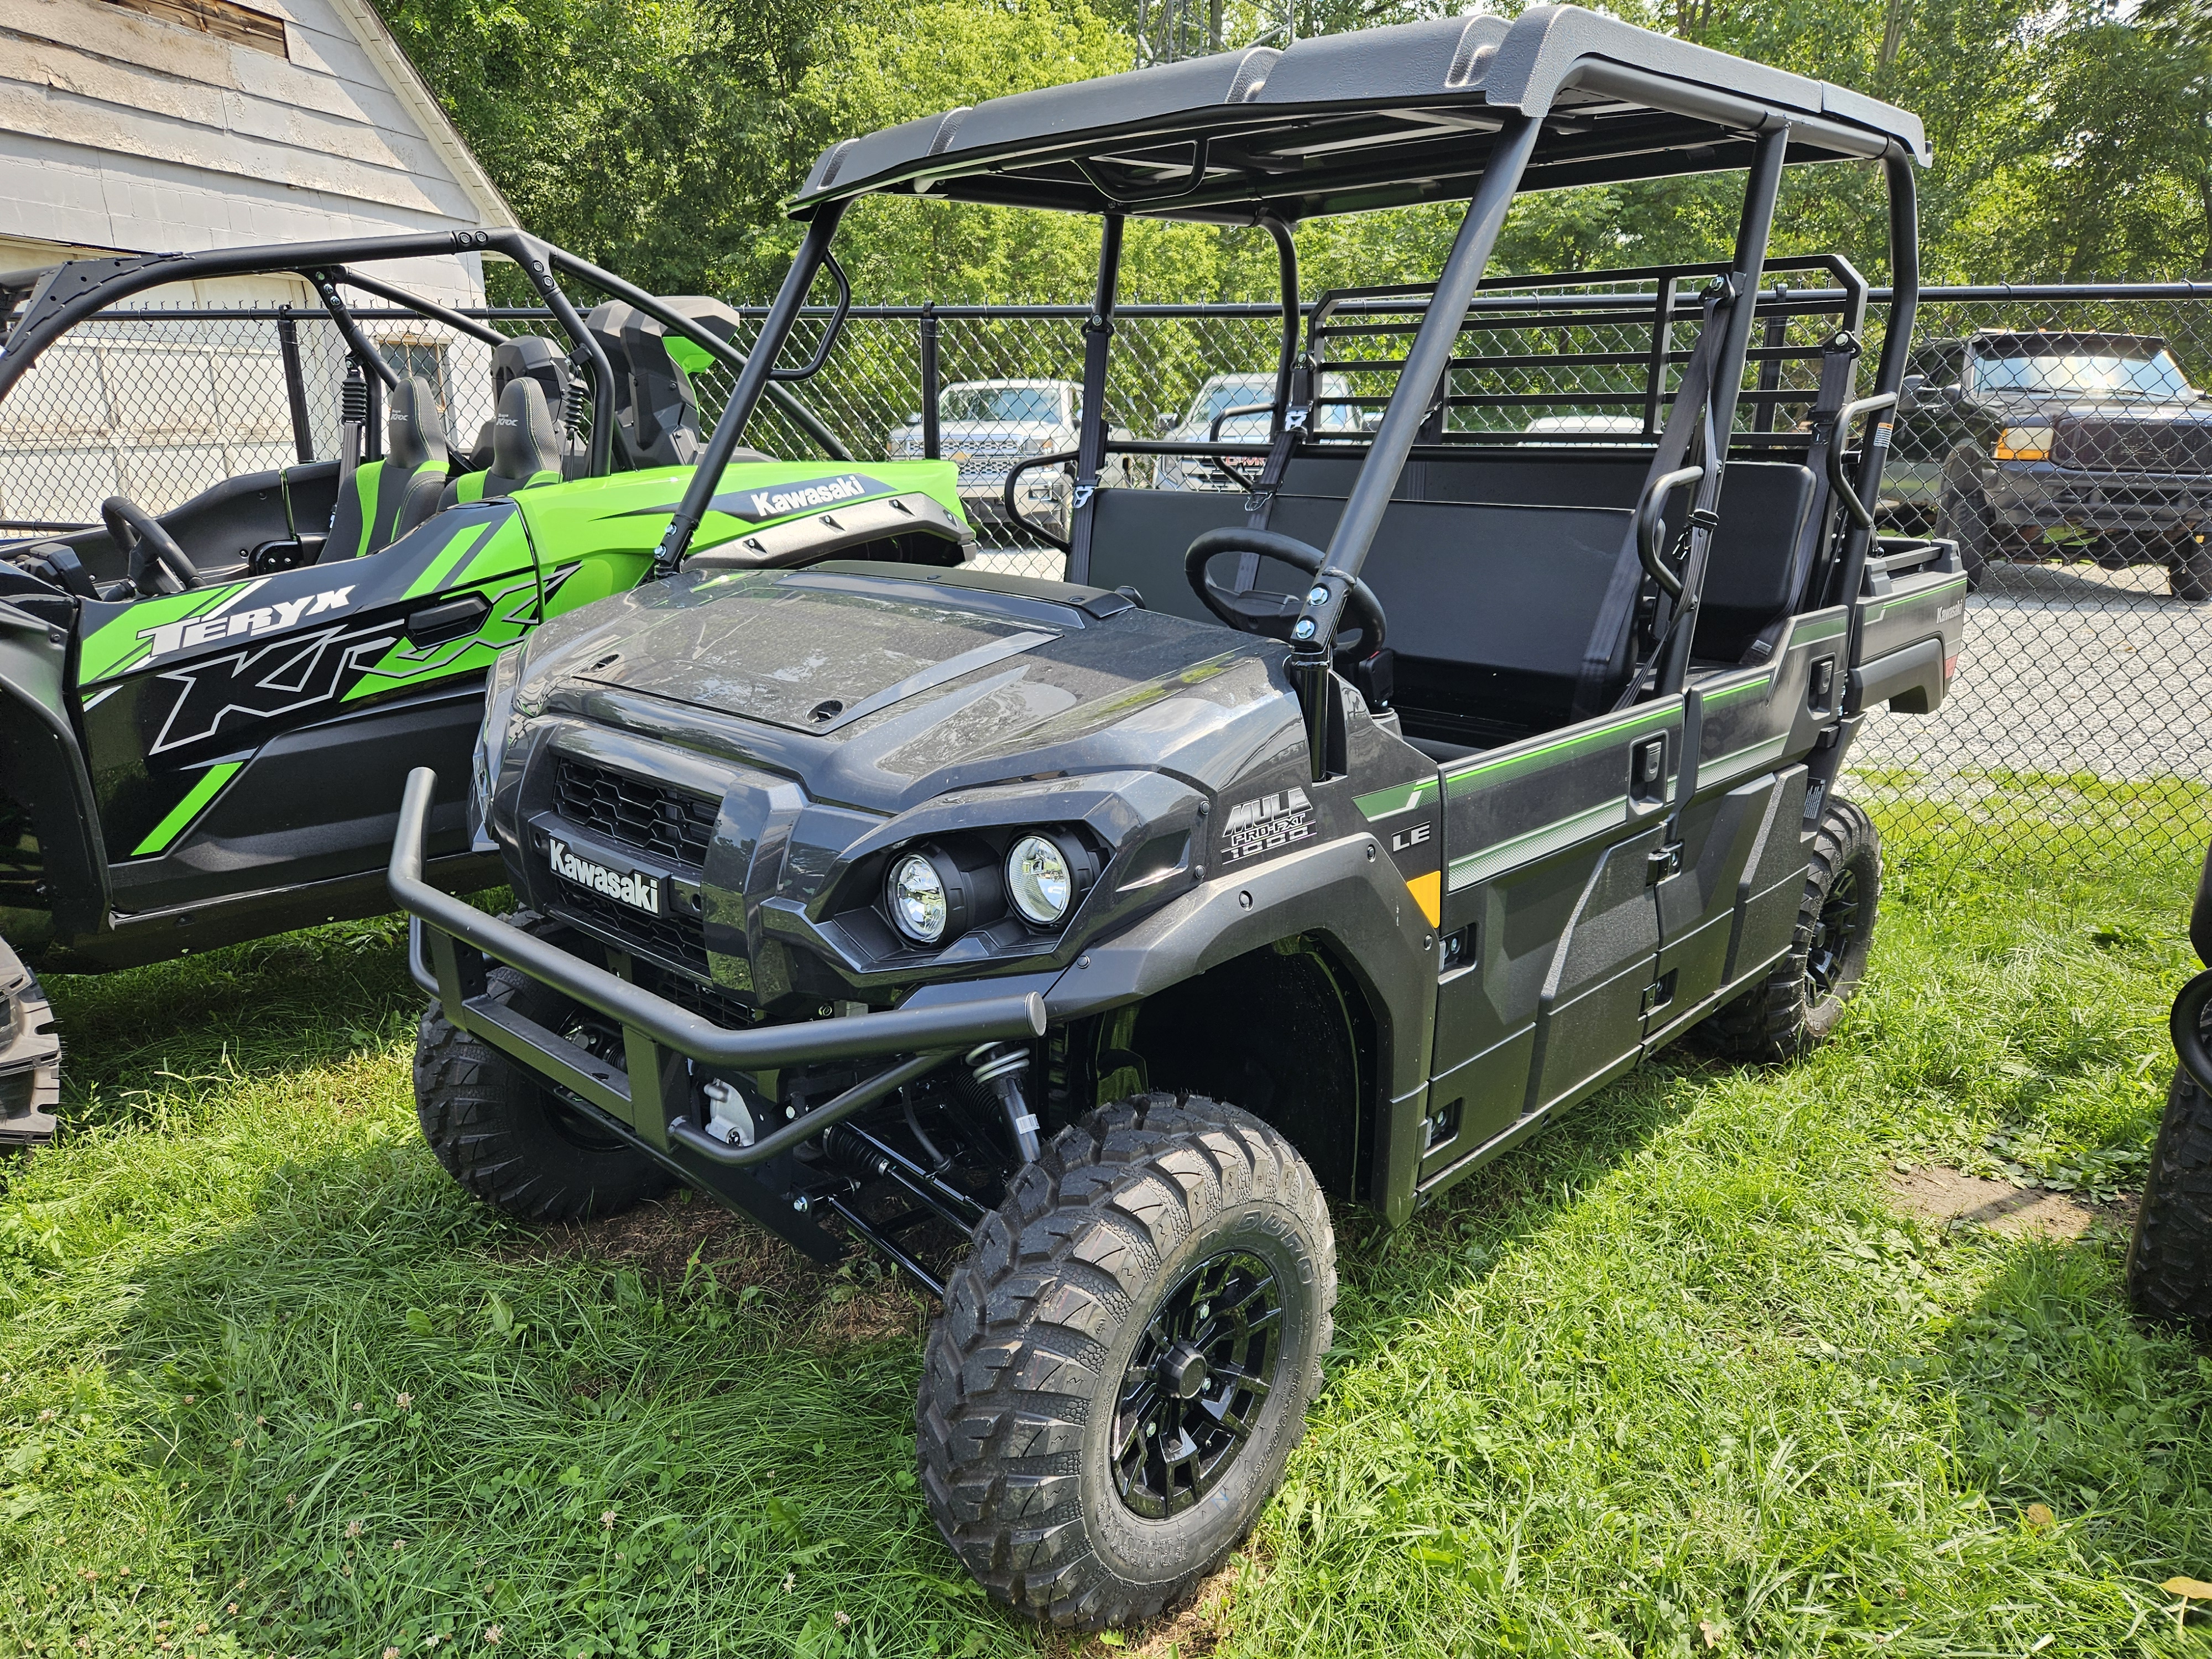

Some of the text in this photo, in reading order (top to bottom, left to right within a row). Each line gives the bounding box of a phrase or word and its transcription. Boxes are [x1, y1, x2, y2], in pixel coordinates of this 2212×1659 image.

[495, 418, 518, 426] KRX
[750, 474, 865, 517] Kawasaki
[138, 585, 357, 659] TERYX
[1937, 599, 1963, 624] Kawasaki
[1222, 787, 1313, 838] MULE
[1231, 813, 1306, 847] PRO-FXT
[1231, 826, 1308, 859] 1000
[1393, 825, 1430, 852] LE
[550, 838, 658, 914] Kawasaki
[1234, 1209, 1314, 1286] DURO
